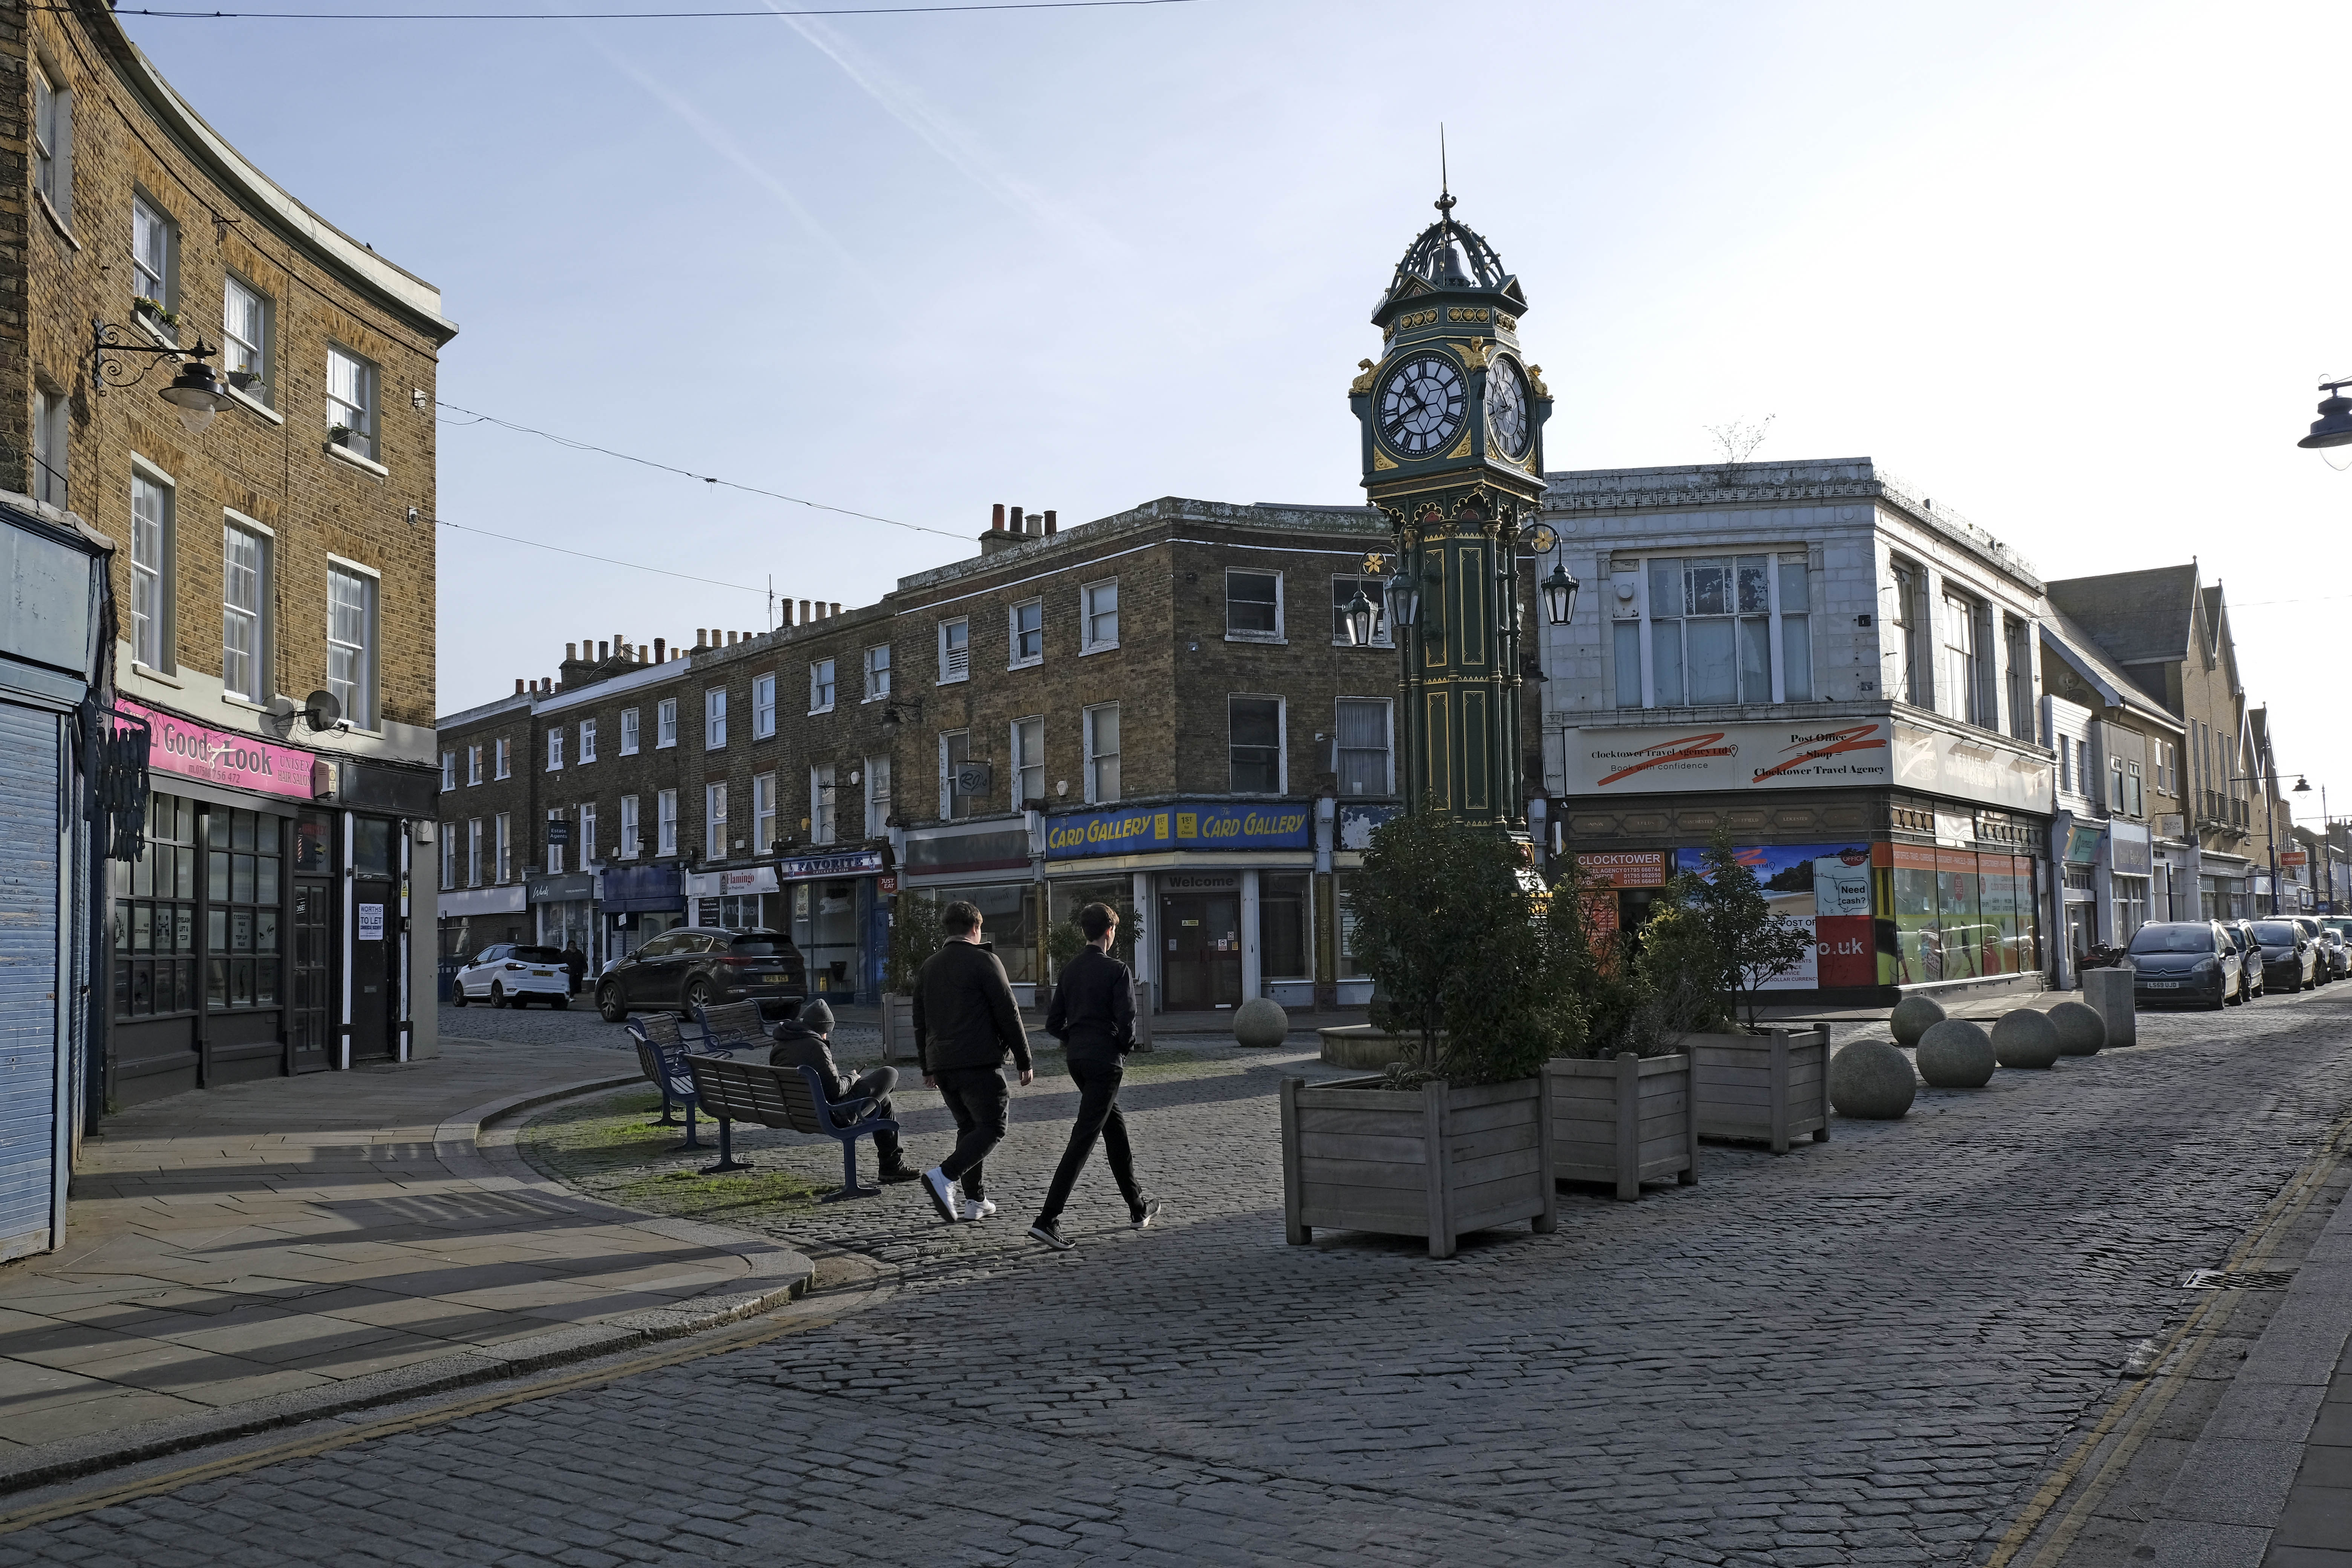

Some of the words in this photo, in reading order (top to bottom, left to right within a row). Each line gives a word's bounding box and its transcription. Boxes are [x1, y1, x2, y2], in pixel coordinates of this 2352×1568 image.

[1791, 734, 1813, 743] Post
[1816, 733, 1847, 741] Office
[164, 723, 208, 763] Good
[223, 740, 273, 776] Look
[1591, 750, 1644, 759] Clocktower
[1645, 748, 1675, 757] Travel
[1678, 748, 1710, 757] Agency
[1807, 750, 1832, 760] Shop
[280, 756, 310, 773] UNISEX
[1658, 762, 1708, 770] confidence
[1754, 768, 1811, 776] Clocktower
[1813, 765, 1846, 774] Travel
[1849, 765, 1885, 775] Agency
[228, 773, 240, 783] 472
[277, 770, 291, 784] HAIR
[292, 773, 311, 787] SALON
[1202, 816, 1240, 838] CARD
[1244, 812, 1305, 835] GALLERY
[1049, 827, 1084, 849] CARD
[1087, 815, 1152, 843] GALLERY
[797, 856, 863, 871] FAVORITE
[1578, 854, 1661, 865] CLOCKTOWER
[727, 872, 754, 886] Flamingo
[1169, 876, 1234, 887] Welcome
